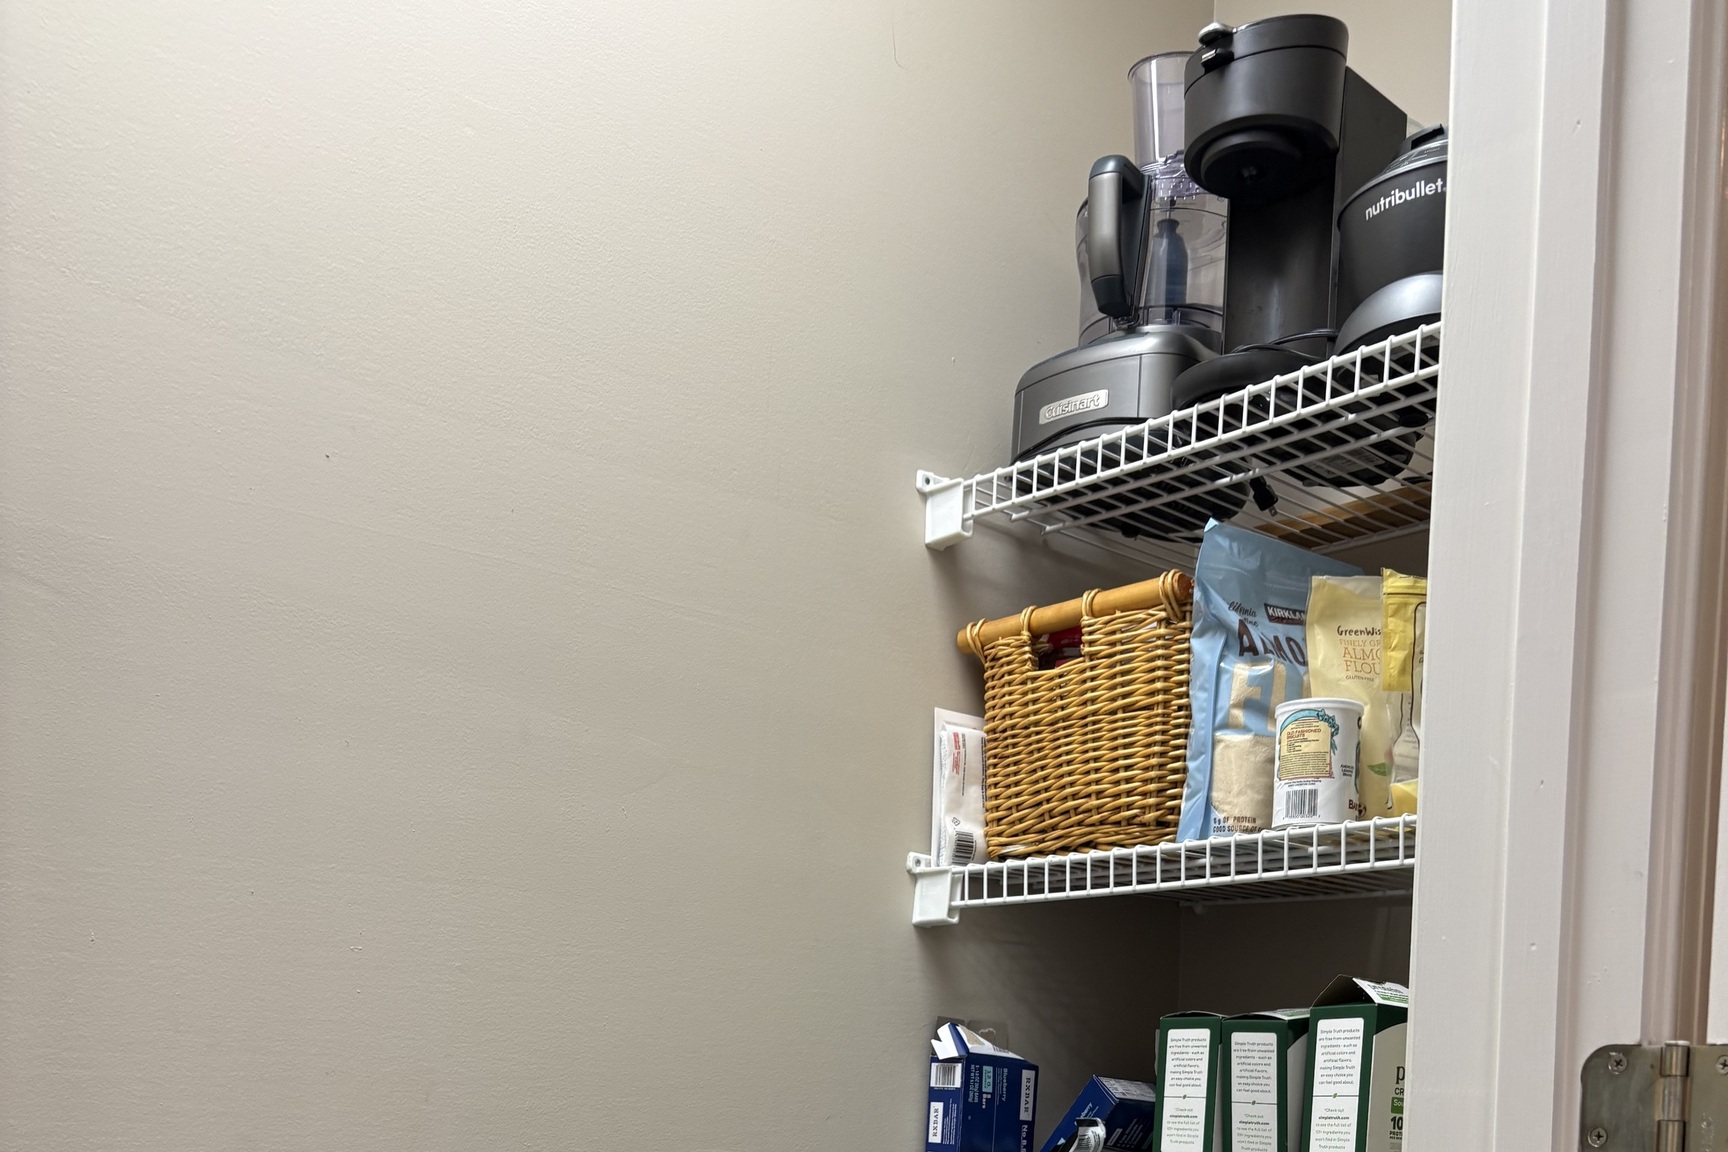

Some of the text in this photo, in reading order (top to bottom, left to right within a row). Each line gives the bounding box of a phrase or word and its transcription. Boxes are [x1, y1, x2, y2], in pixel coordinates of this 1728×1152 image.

[1365, 178, 1443, 221] nutribullet
[1045, 394, 1100, 420] Cuisinart
[1337, 625, 1381, 636] GreenWis
